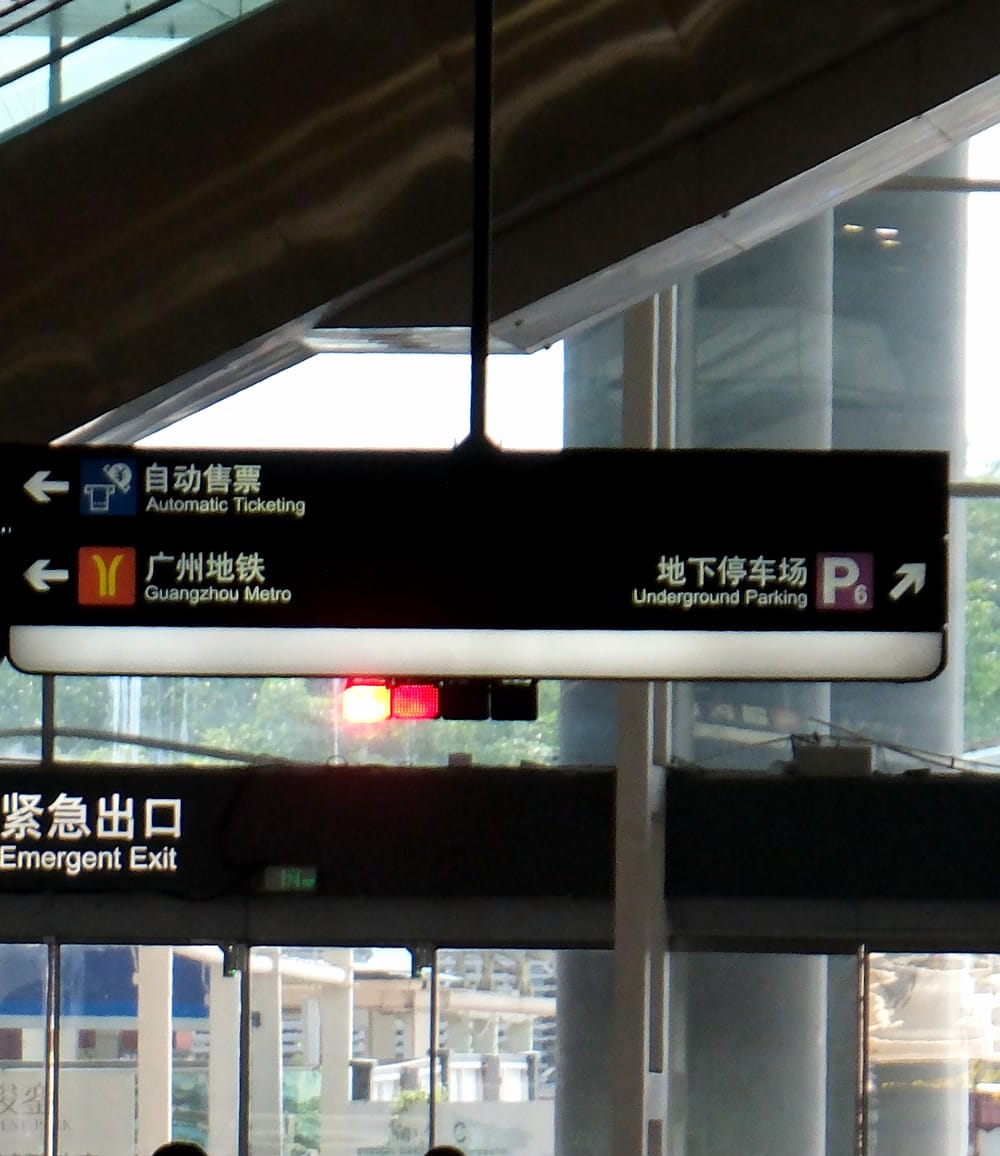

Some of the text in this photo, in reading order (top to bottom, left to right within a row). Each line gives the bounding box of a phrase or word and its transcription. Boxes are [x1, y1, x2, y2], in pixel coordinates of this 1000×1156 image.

[144, 462, 263, 494] 自动售票
[145, 496, 306, 517] Automatic Ticketing
[144, 551, 266, 583] 广州地铁
[657, 554, 808, 587] 地下停车场
[144, 585, 292, 605] Guangzhou Metro
[633, 588, 808, 609] Underground Parking
[0, 791, 182, 840] 紧急出口
[129, 845, 178, 872] Exit
